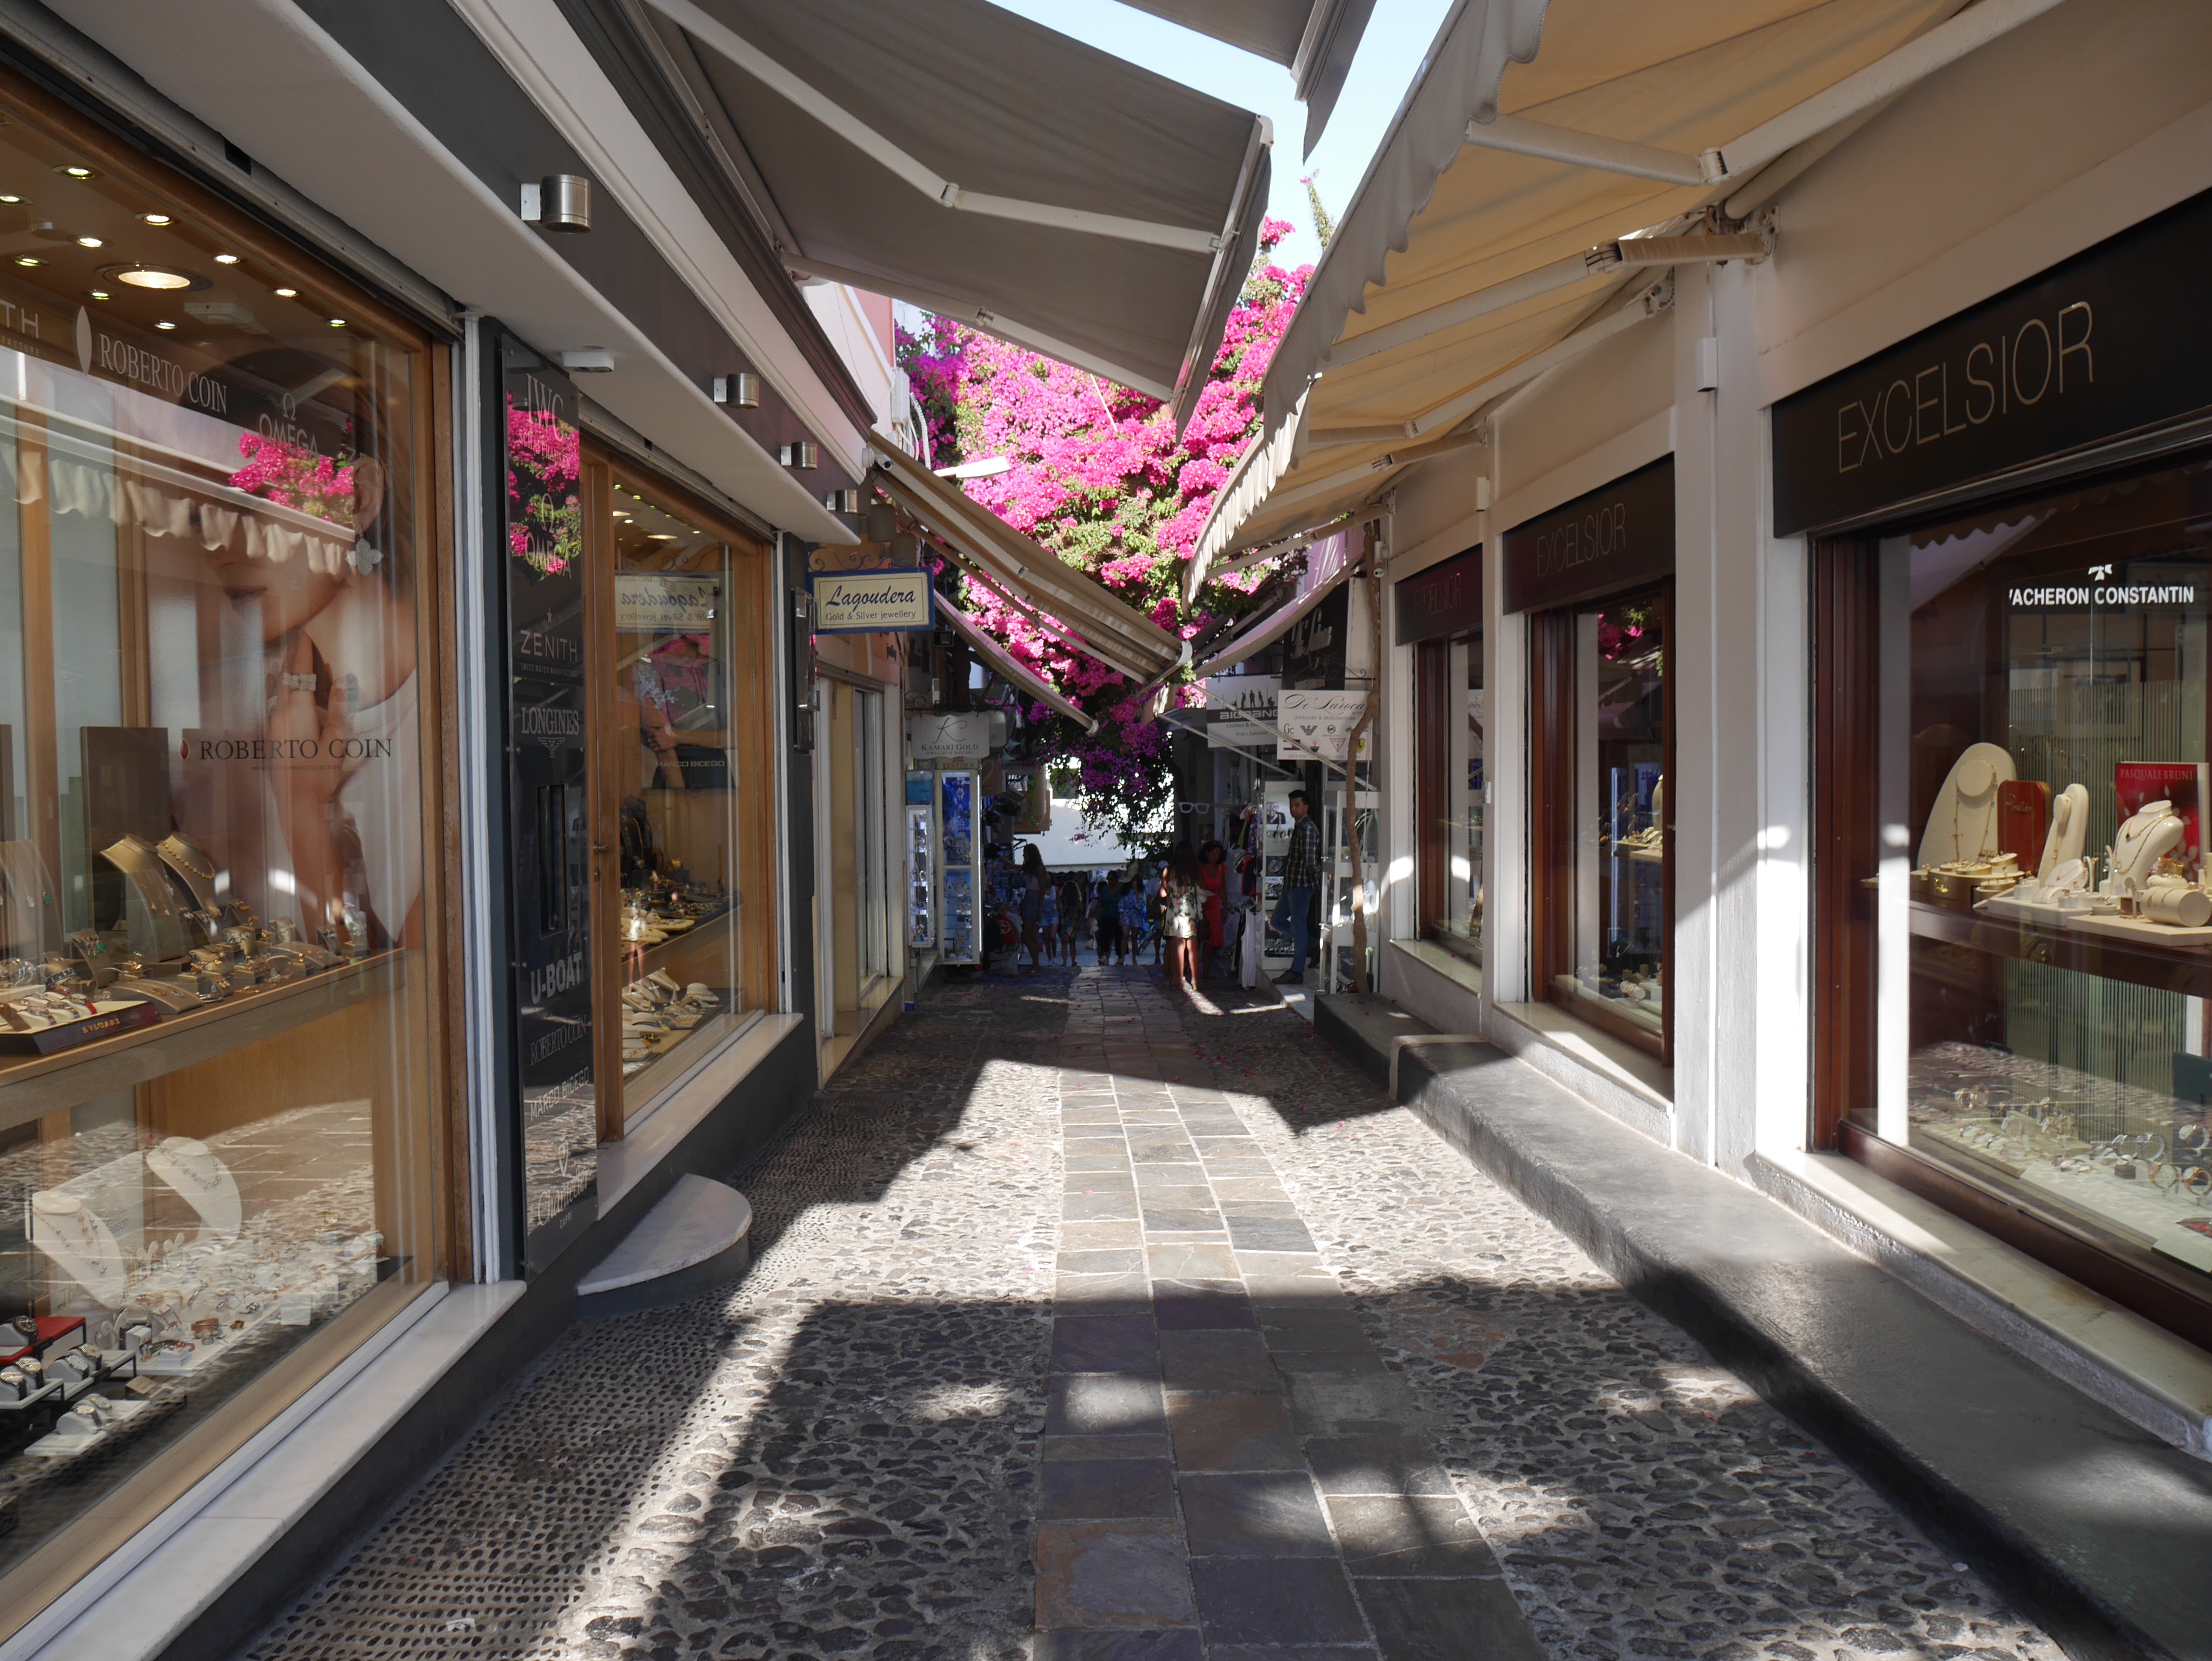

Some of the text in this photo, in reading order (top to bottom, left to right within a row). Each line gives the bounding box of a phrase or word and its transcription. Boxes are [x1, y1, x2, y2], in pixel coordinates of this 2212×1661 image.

[98, 333, 227, 415] ROBERTO COIN
[1838, 301, 2094, 473] EXCELSIOR
[527, 373, 564, 442] IWC
[259, 413, 321, 461] OMEGA
[525, 531, 572, 579] OMEGA
[1537, 502, 1626, 577] EXCELSIOR
[825, 585, 916, 612] Lagoudera
[826, 612, 844, 620] Gold
[856, 611, 878, 620] Silver
[881, 610, 916, 620] jewellery
[2094, 586, 2194, 605] CONSTANTIN
[520, 630, 578, 662] ZENITH
[521, 707, 579, 736] LONGINES
[198, 738, 392, 760] ROBERTO COIN
[2120, 769, 2192, 780] PASQUALE BRUNI
[530, 951, 583, 1004] U-BOAT
[530, 1015, 587, 1067] ROBERTO COIN
[530, 1066, 590, 1121] MARCO BICEGO
